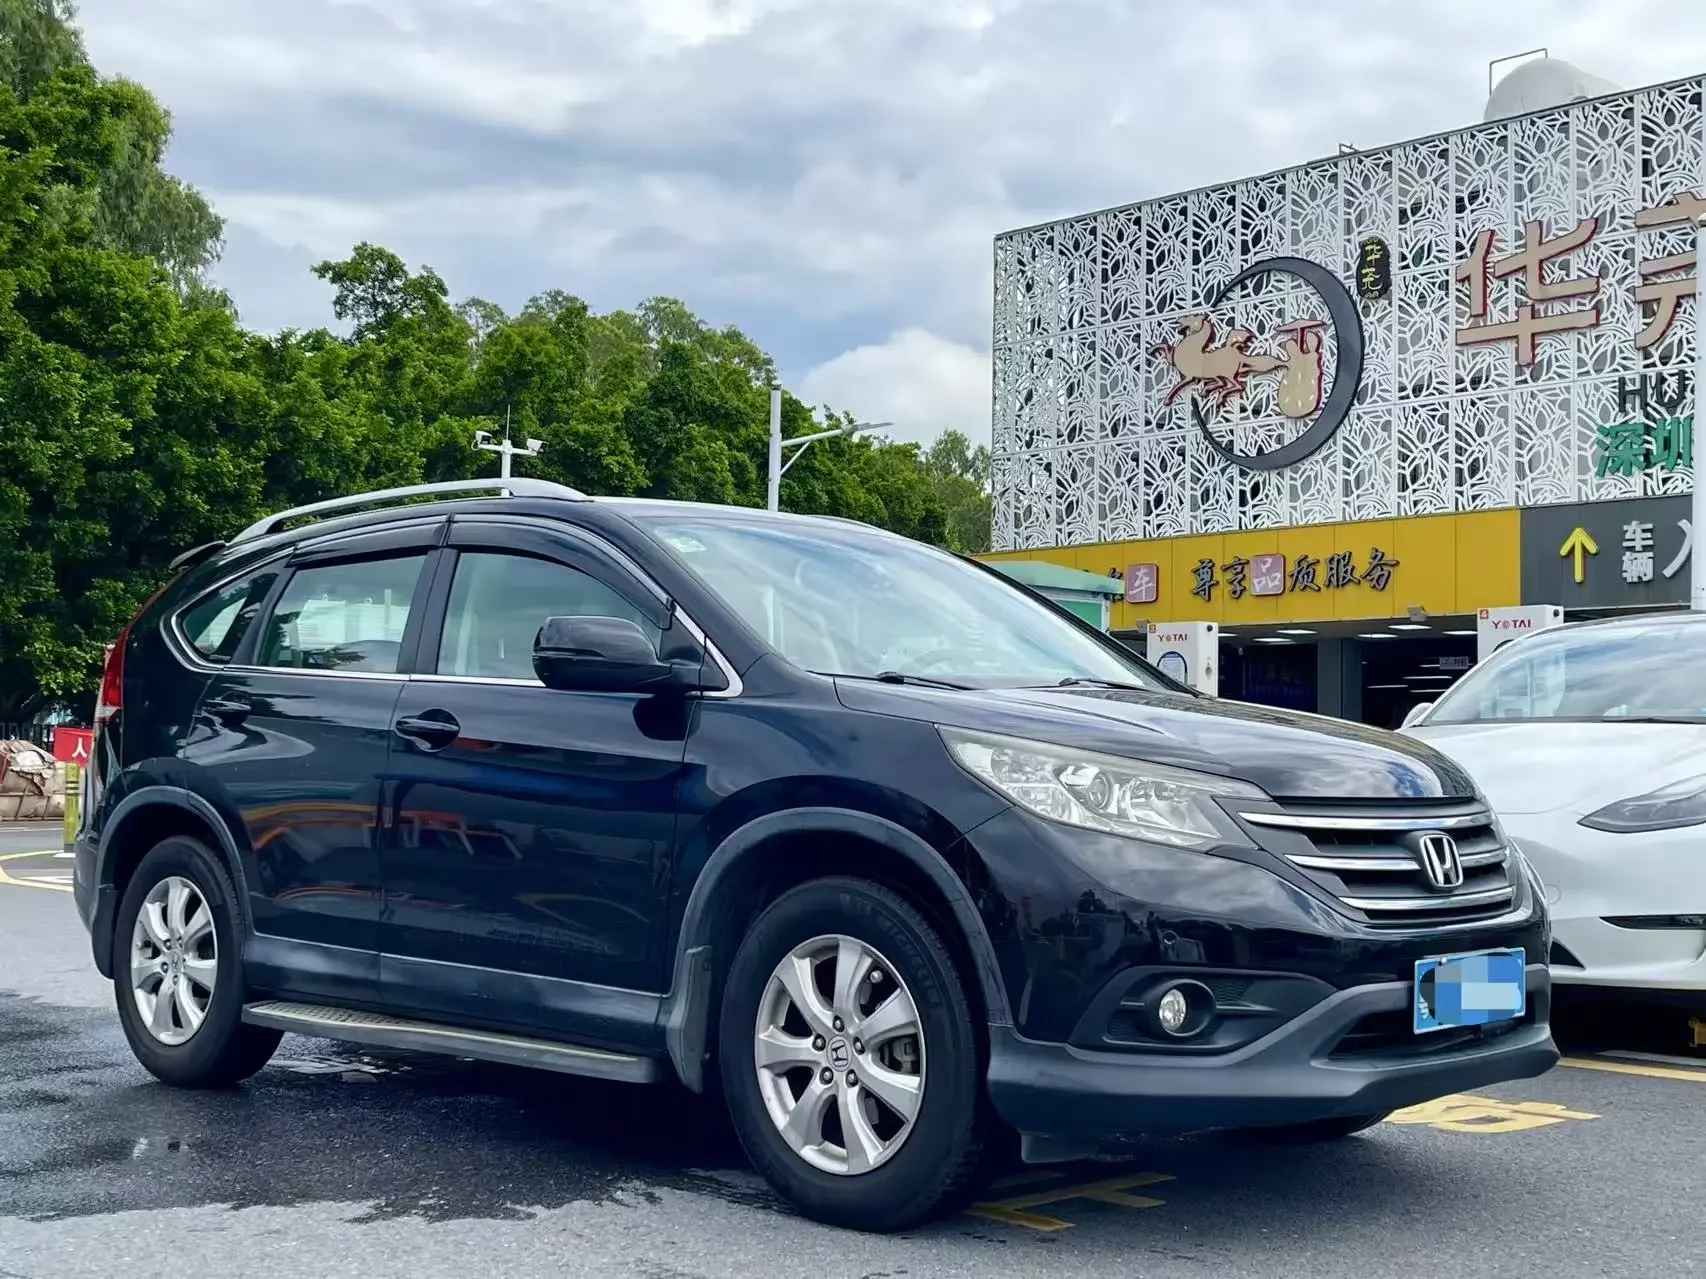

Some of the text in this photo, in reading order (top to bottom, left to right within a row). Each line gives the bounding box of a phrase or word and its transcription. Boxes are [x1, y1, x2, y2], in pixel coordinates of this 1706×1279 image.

[1595, 416, 1693, 478] 深圳
[1191, 547, 1399, 601] 尊享品质服务
